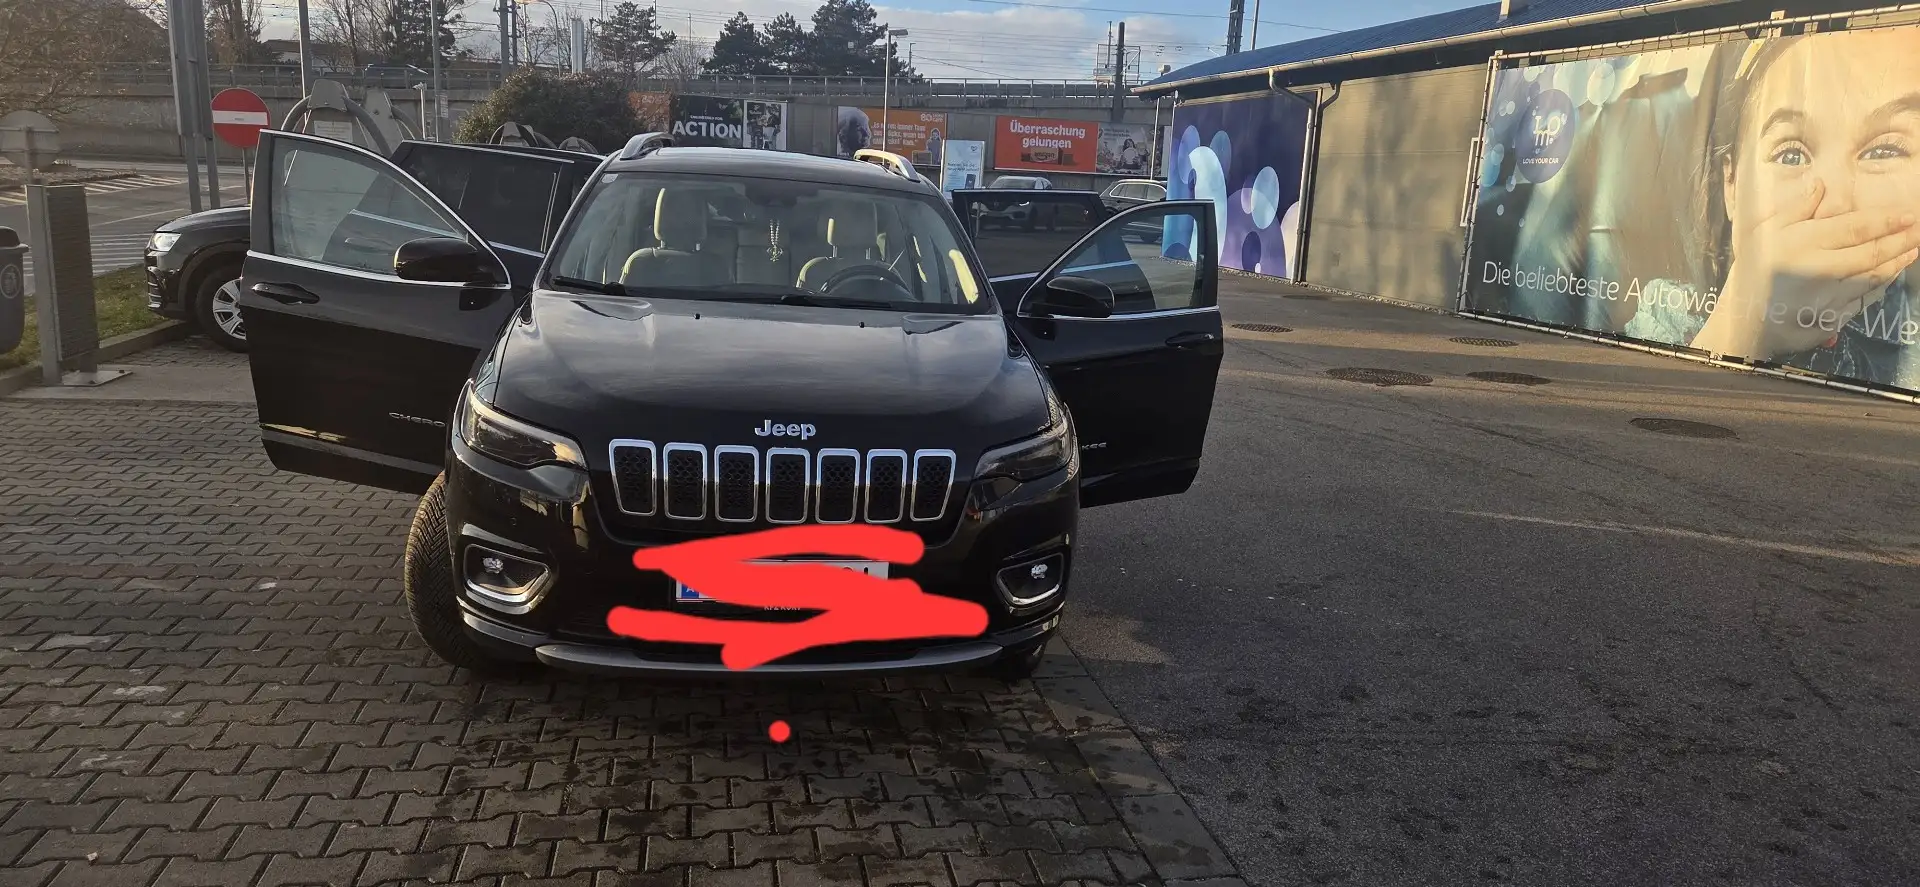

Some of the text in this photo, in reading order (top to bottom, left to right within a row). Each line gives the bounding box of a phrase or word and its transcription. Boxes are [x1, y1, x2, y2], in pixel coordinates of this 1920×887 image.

[672, 120, 742, 139] ACTION
[1010, 119, 1086, 139] Überraschung
[1023, 135, 1072, 149] gelungen
[1482, 261, 1511, 286] Die
[1514, 263, 1620, 300] beliebteste
[1796, 296, 1850, 333] der
[388, 412, 446, 427] CHERO
[754, 419, 817, 441] Jeep
